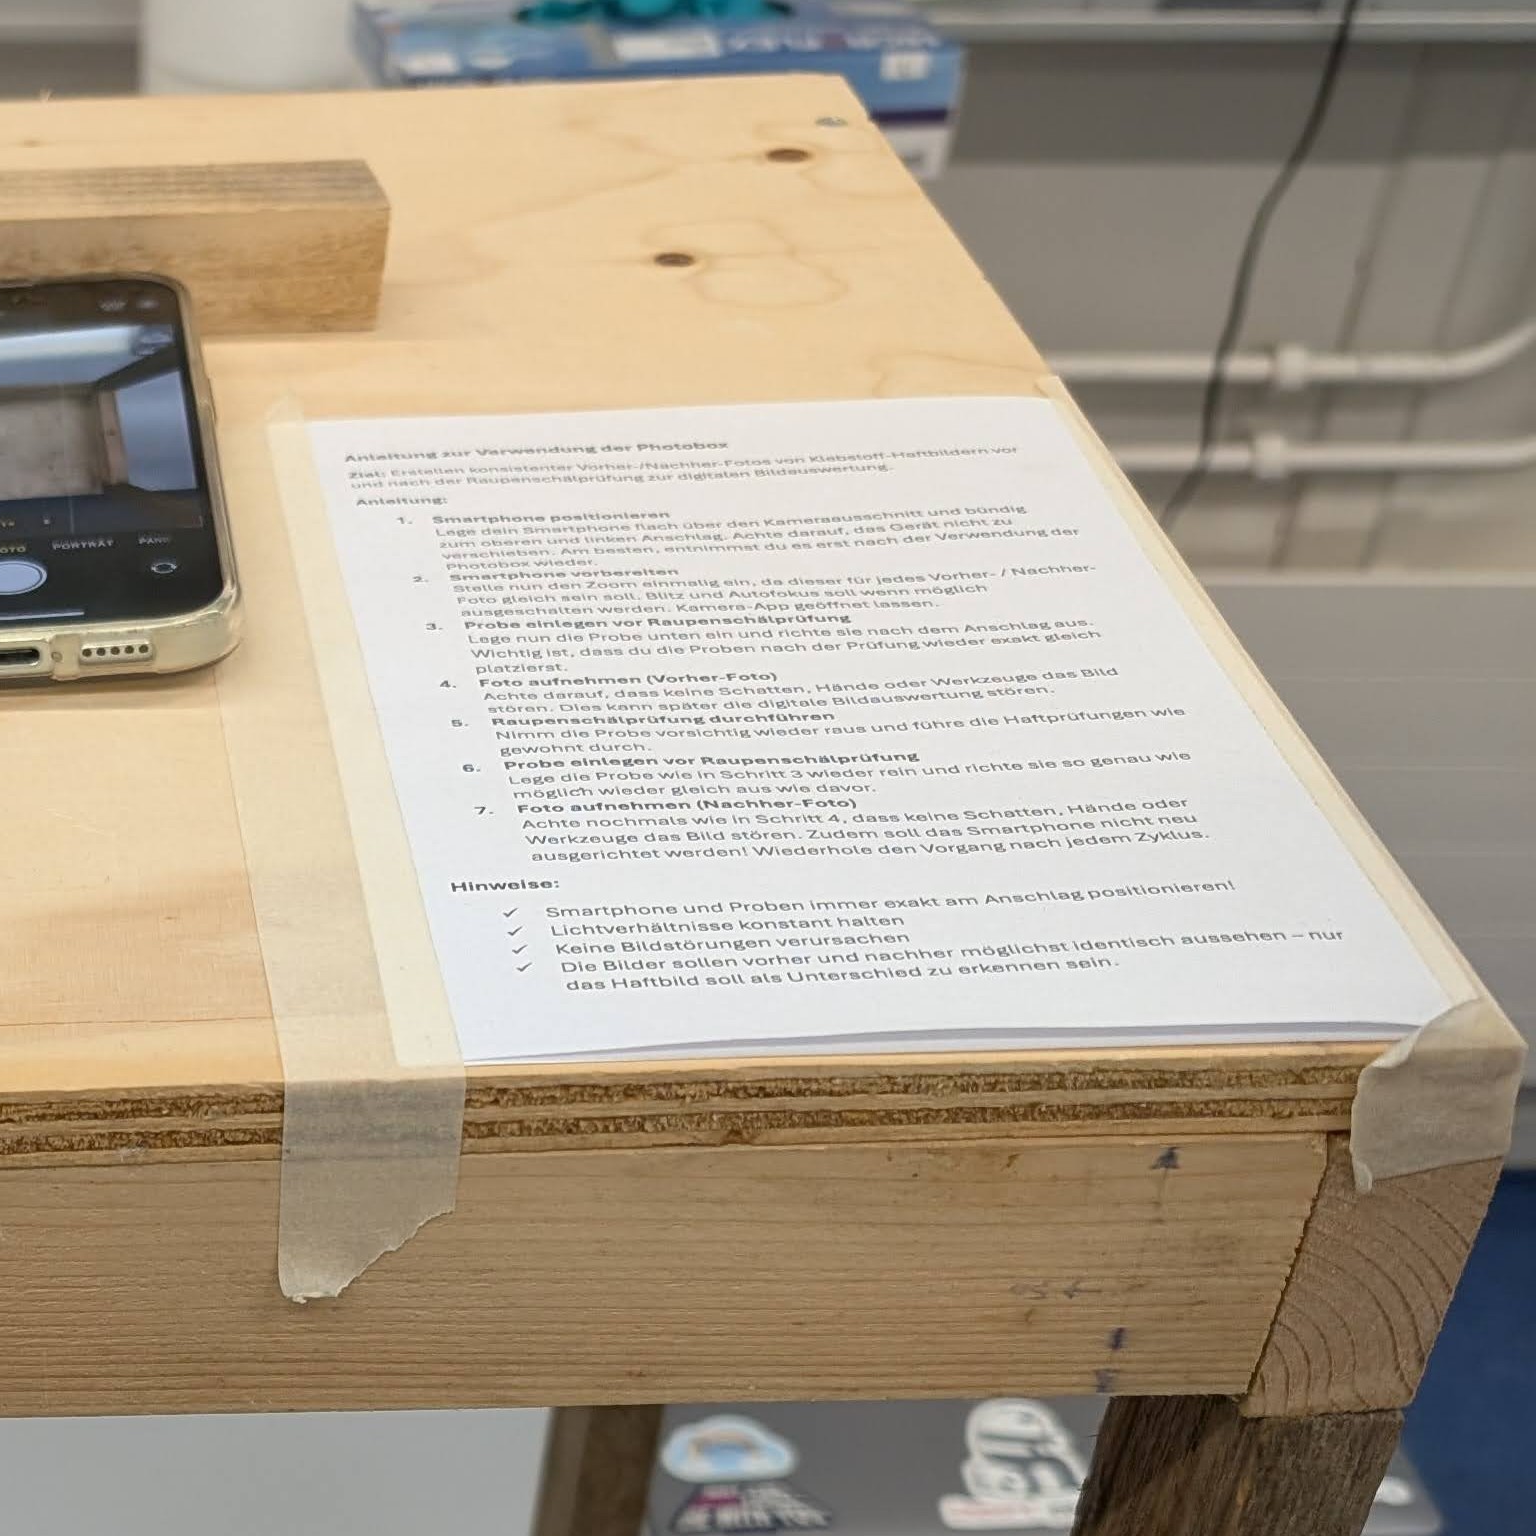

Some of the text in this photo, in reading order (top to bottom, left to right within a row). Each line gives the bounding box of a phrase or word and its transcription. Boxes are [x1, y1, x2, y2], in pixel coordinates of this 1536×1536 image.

[342, 451, 438, 462] Anleitung
[474, 445, 599, 457] Verwendung
[634, 440, 729, 450] Photobox
[354, 495, 448, 507] Anleitung:
[431, 514, 547, 526] Smartphone
[547, 510, 672, 523] positionieren
[434, 505, 1029, 539] Lege dein Smartphone flach über den Kameraausschnitt und bündig
[447, 570, 569, 583] Smartphone
[568, 567, 680, 577] vorbereiten
[463, 620, 522, 629] Probe
[523, 618, 610, 630] einlegen
[610, 619, 645, 627] vor
[645, 613, 853, 628] Raupenschälprüfung
[469, 648, 544, 660] Wichtig
[544, 647, 576, 658] ist,
[577, 646, 625, 656] dass
[653, 645, 686, 654] die
[687, 643, 757, 653] Proben
[757, 642, 808, 652] nach
[808, 641, 843, 650] der
[844, 638, 922, 651] Prüfung
[918, 636, 988, 647] wieder
[986, 633, 1042, 644] exakt
[1040, 629, 1104, 643] gleich
[477, 677, 524, 687] Foto
[525, 674, 643, 686] aufnehmen
[643, 670, 779, 685] (Vorher-Foto)
[481, 666, 1119, 701] Achte darauf, dass keine Schatten, Hände oder Werkzeuge das Bild
[490, 714, 707, 729] Raupenschälprüfung
[705, 711, 837, 723] durchführen
[502, 758, 566, 769] Probe
[568, 756, 661, 769] einlegen
[661, 757, 698, 766] vor
[698, 751, 922, 767] Raupenschälprüfung
[507, 773, 557, 787] Lege
[558, 771, 592, 782] die
[593, 770, 655, 781] Probe
[655, 769, 694, 780] wie
[717, 768, 788, 779] Schritt
[803, 766, 876, 778] wieder
[876, 765, 918, 776] rein
[919, 764, 961, 775] und
[962, 760, 1025, 773] richte
[1024, 758, 1059, 769] sie
[1087, 755, 1155, 768] genau
[1152, 751, 1193, 762] wie
[511, 781, 876, 800] möglich wieder gleich aus wie davor.
[515, 802, 565, 813] Foto
[567, 799, 692, 812] aufnehmen
[694, 796, 859, 811] (Nachher-Foto)
[519, 817, 582, 830] Achte
[583, 815, 689, 827] nochmals
[688, 814, 729, 825] wie
[753, 813, 826, 824] Schritt
[848, 811, 902, 823] dass
[902, 810, 961, 822] keine
[960, 805, 1065, 821] Schatten,
[1064, 801, 1139, 815] Hände
[1138, 797, 1189, 810] oder
[525, 814, 1199, 848] Werkzeuge das Bild stören. Zudem soll das Smartphone nicht neu
[529, 828, 1212, 865] ausgerichtet werden! Wiederhole den Vorgang nach jedem Zyklus.
[449, 877, 560, 892] Hinweise:
[544, 903, 679, 921] Smartphone
[680, 901, 725, 913] und
[727, 899, 806, 912] Proben
[807, 897, 881, 910] immer
[880, 895, 941, 908] exakt
[980, 888, 1087, 907] Anschlag
[1084, 879, 1238, 901] positionieren!
[549, 914, 905, 936] Lichtverhältnisse konstant halten
[554, 931, 911, 955] Keine Bildstörungen verursachen
[559, 960, 598, 973] Die
[601, 958, 666, 972] Bilder
[669, 955, 739, 969] sollen
[739, 952, 814, 966] vorher
[814, 950, 861, 964] und
[861, 946, 956, 962] nachher
[957, 940, 1072, 960] möglichst
[1069, 934, 1177, 951] identisch
[1176, 929, 1289, 945] aussehen
[1306, 930, 1345, 940] nur
[564, 977, 607, 991] das
[609, 974, 701, 989] Haftbild
[702, 972, 745, 985] soll
[747, 971, 783, 984] als
[784, 965, 923, 982] Unterschied
[954, 958, 1062, 974] erkennen
[1062, 955, 1120, 969] sein.
